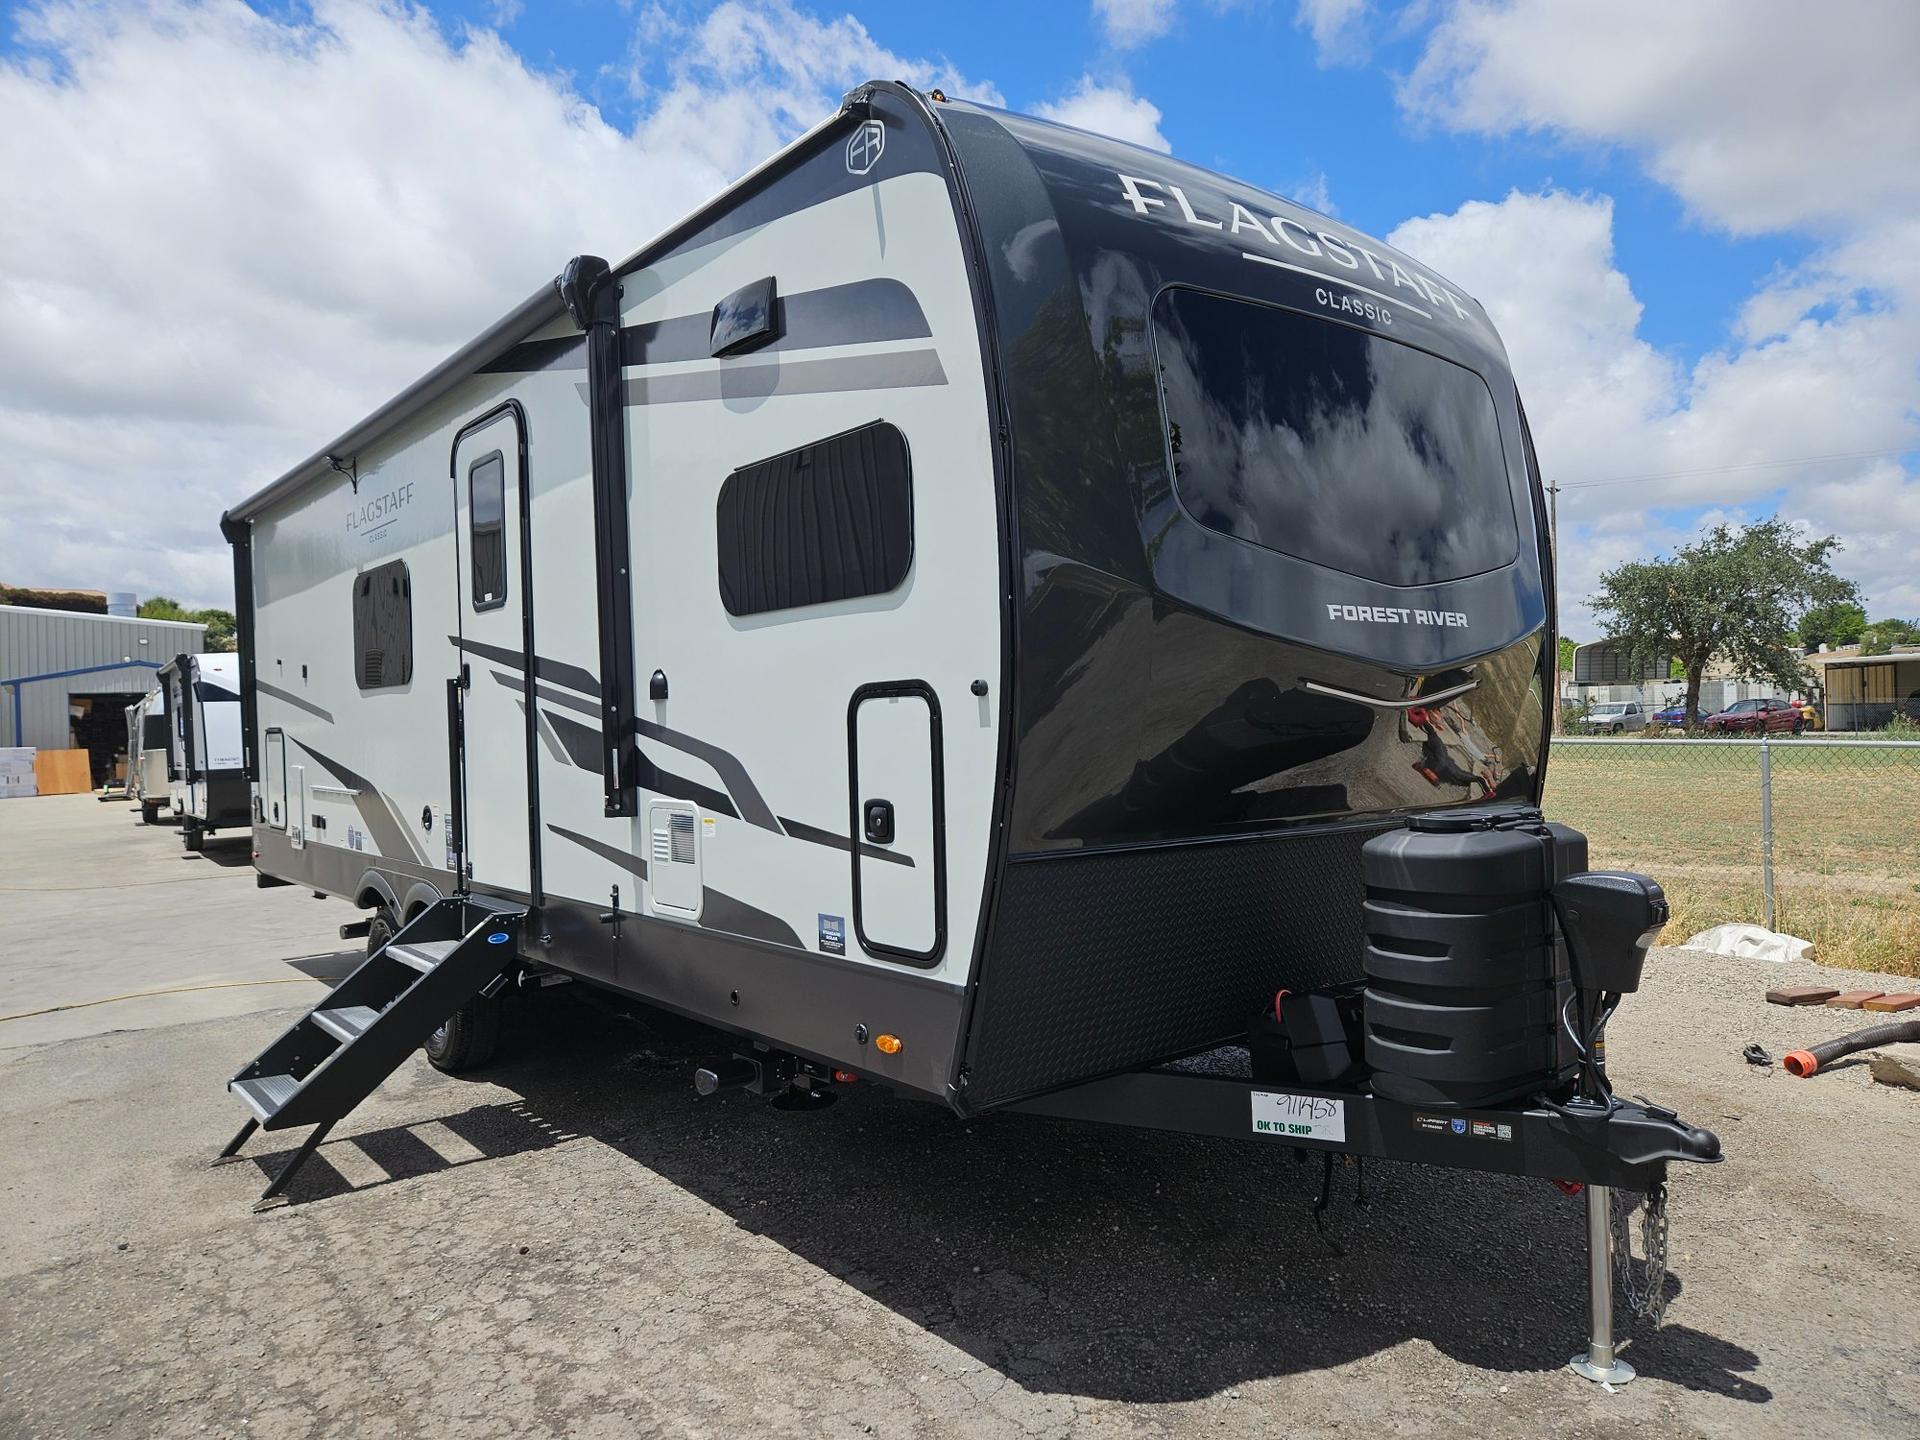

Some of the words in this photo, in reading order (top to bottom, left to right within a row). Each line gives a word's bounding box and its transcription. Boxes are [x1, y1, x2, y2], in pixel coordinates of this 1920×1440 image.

[1117, 173, 1474, 321] FLAGSTAFF
[1315, 287, 1392, 326] CLASSIC
[345, 481, 414, 533] FLAGSTAFF
[1326, 603, 1411, 624] FOREST
[1413, 608, 1470, 628] RIVER
[1257, 1120, 1271, 1131] OK
[1273, 1121, 1286, 1133] TO
[1288, 1123, 1313, 1136] SHIP
